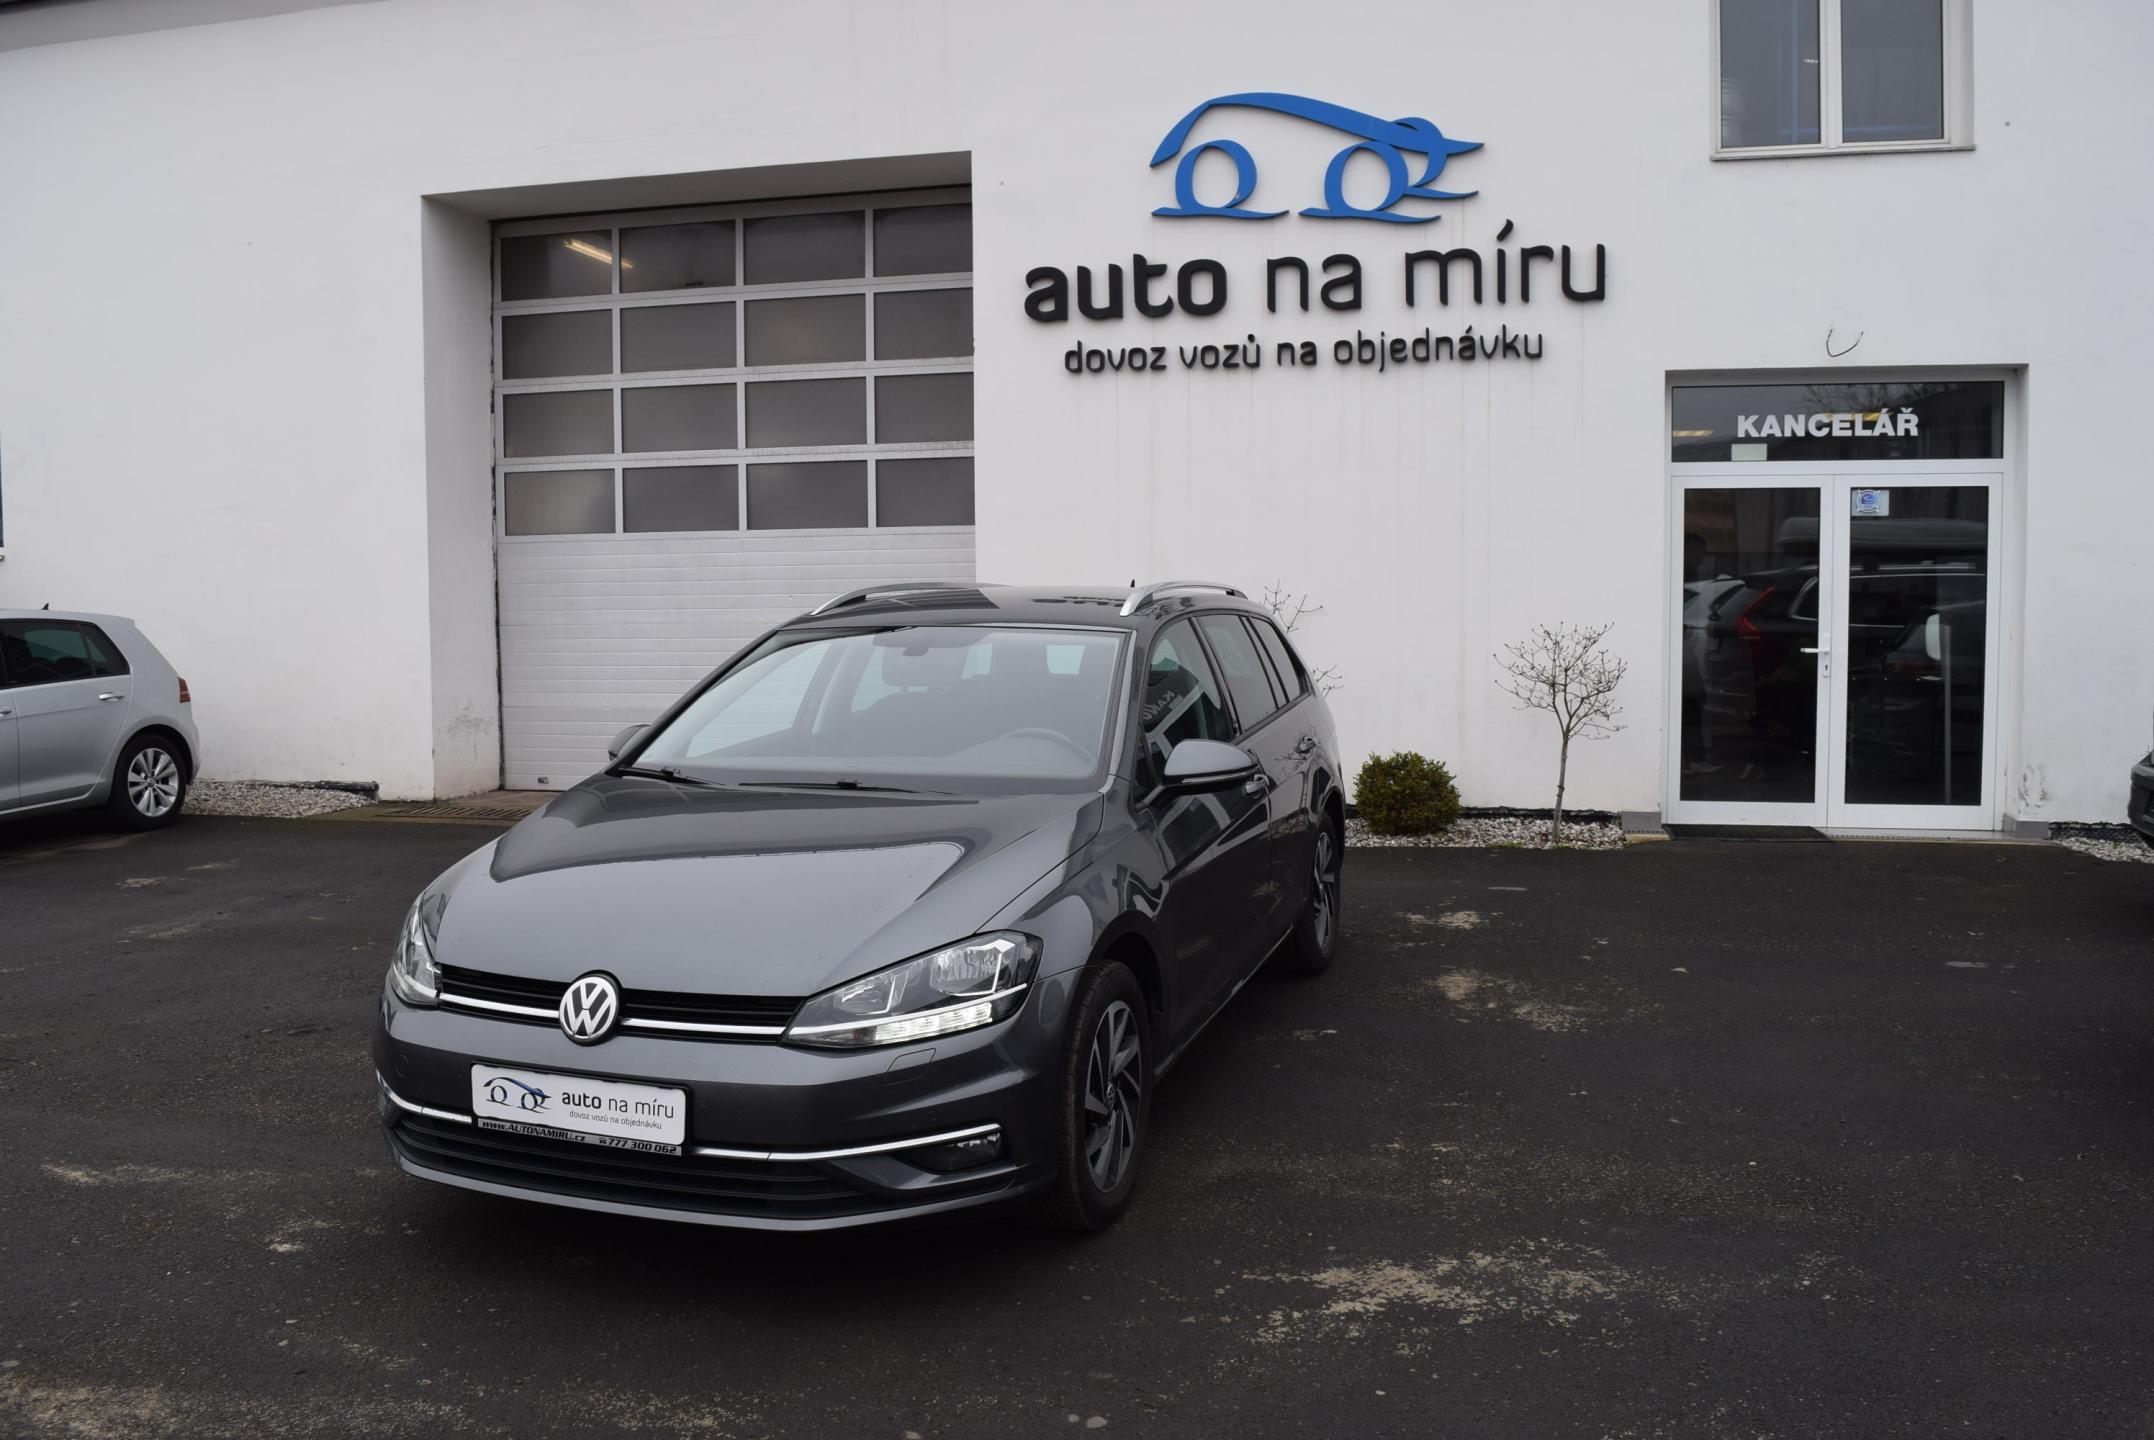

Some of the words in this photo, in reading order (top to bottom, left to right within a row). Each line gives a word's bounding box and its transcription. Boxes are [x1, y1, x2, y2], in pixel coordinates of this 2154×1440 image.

[1024, 253, 1228, 322] auto
[1266, 253, 1362, 313] na
[1405, 219, 1606, 307] míru
[1064, 340, 1167, 375] dovoz
[1179, 333, 1261, 370] vozů
[1277, 339, 1317, 367] na
[1333, 324, 1544, 372] objednávku
[1737, 407, 1919, 438] KANCELÁŘ
[561, 1091, 602, 1109] auto
[608, 1098, 628, 1113] na
[635, 1098, 674, 1119] míru
[569, 1110, 590, 1120] dovoz
[620, 1117, 662, 1129] objednávku
[608, 1137, 628, 1148] 777
[630, 1141, 652, 1152] 300
[653, 1144, 677, 1155] 062
